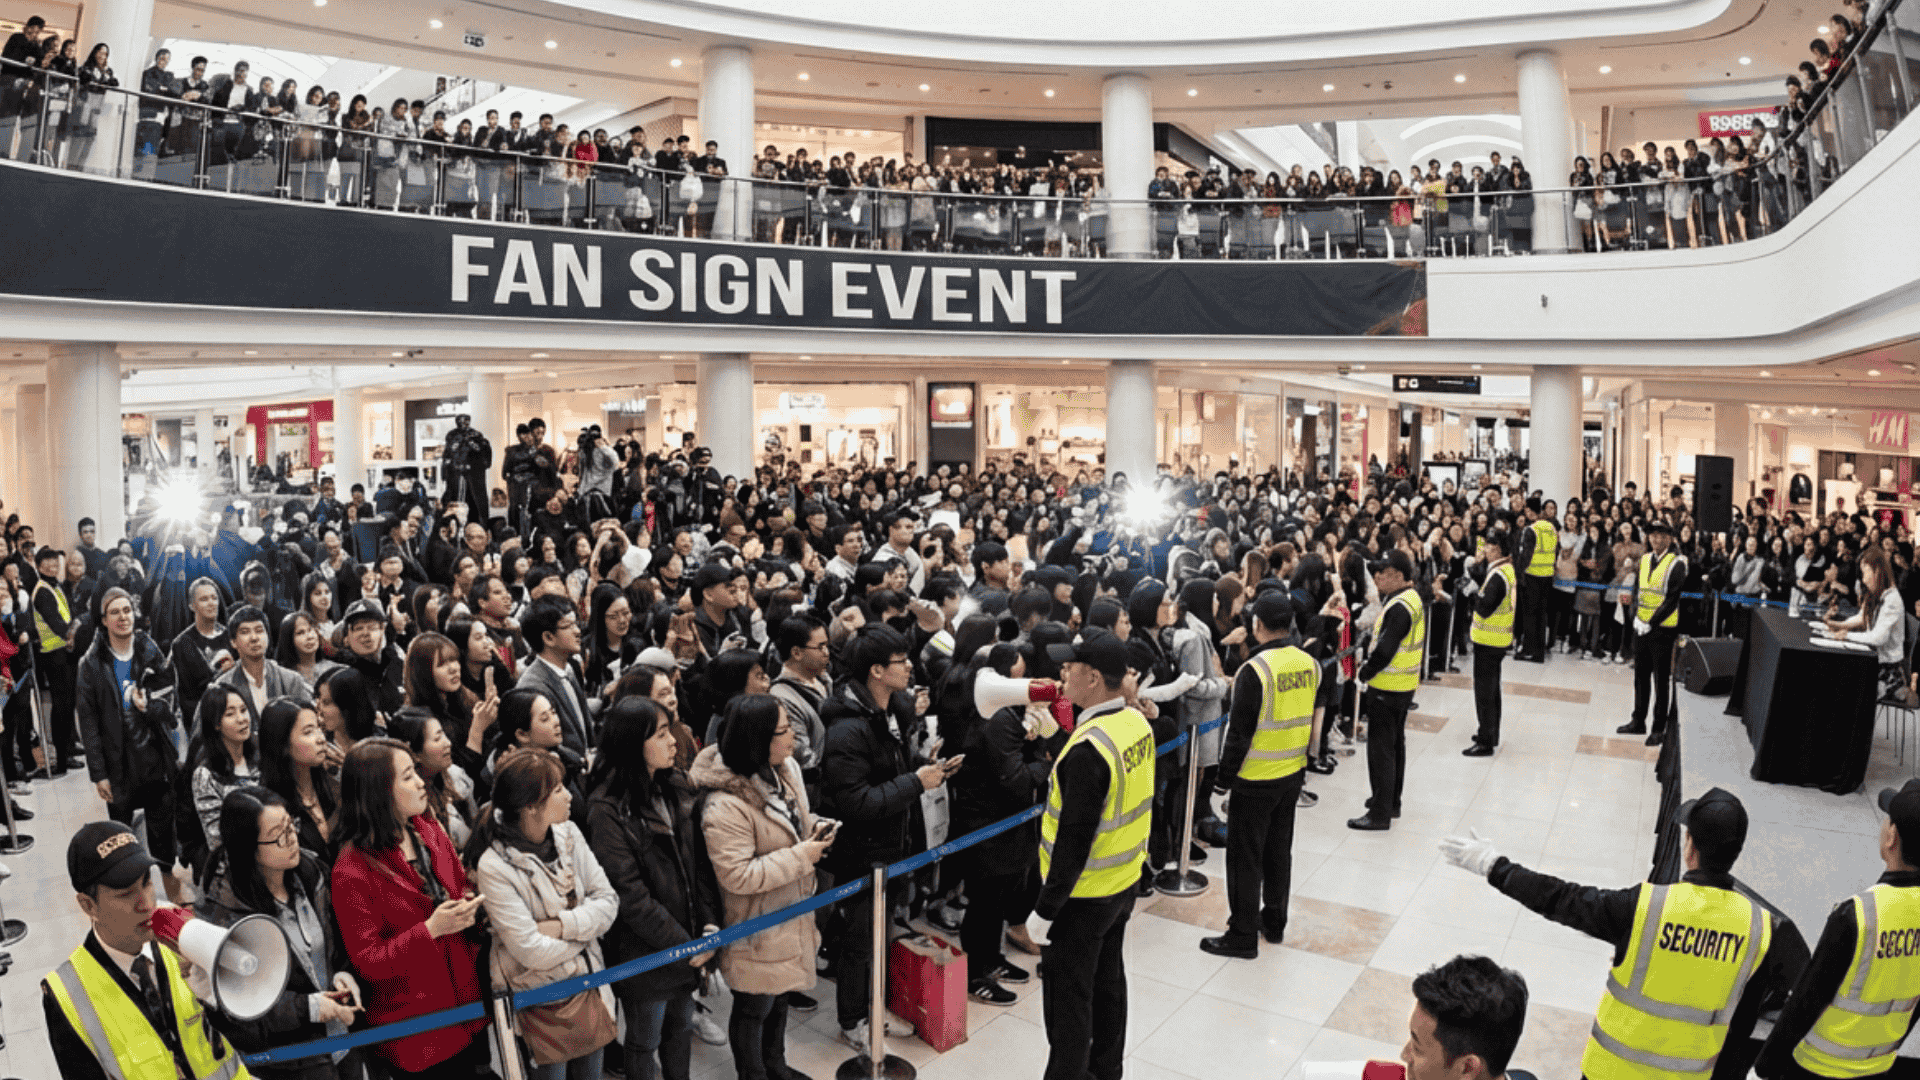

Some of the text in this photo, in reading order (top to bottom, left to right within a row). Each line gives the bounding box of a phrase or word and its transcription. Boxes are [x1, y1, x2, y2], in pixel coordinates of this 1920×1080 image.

[451, 233, 1078, 324] FAN SIGN EVENT
[1659, 921, 1746, 964] SECURITY
